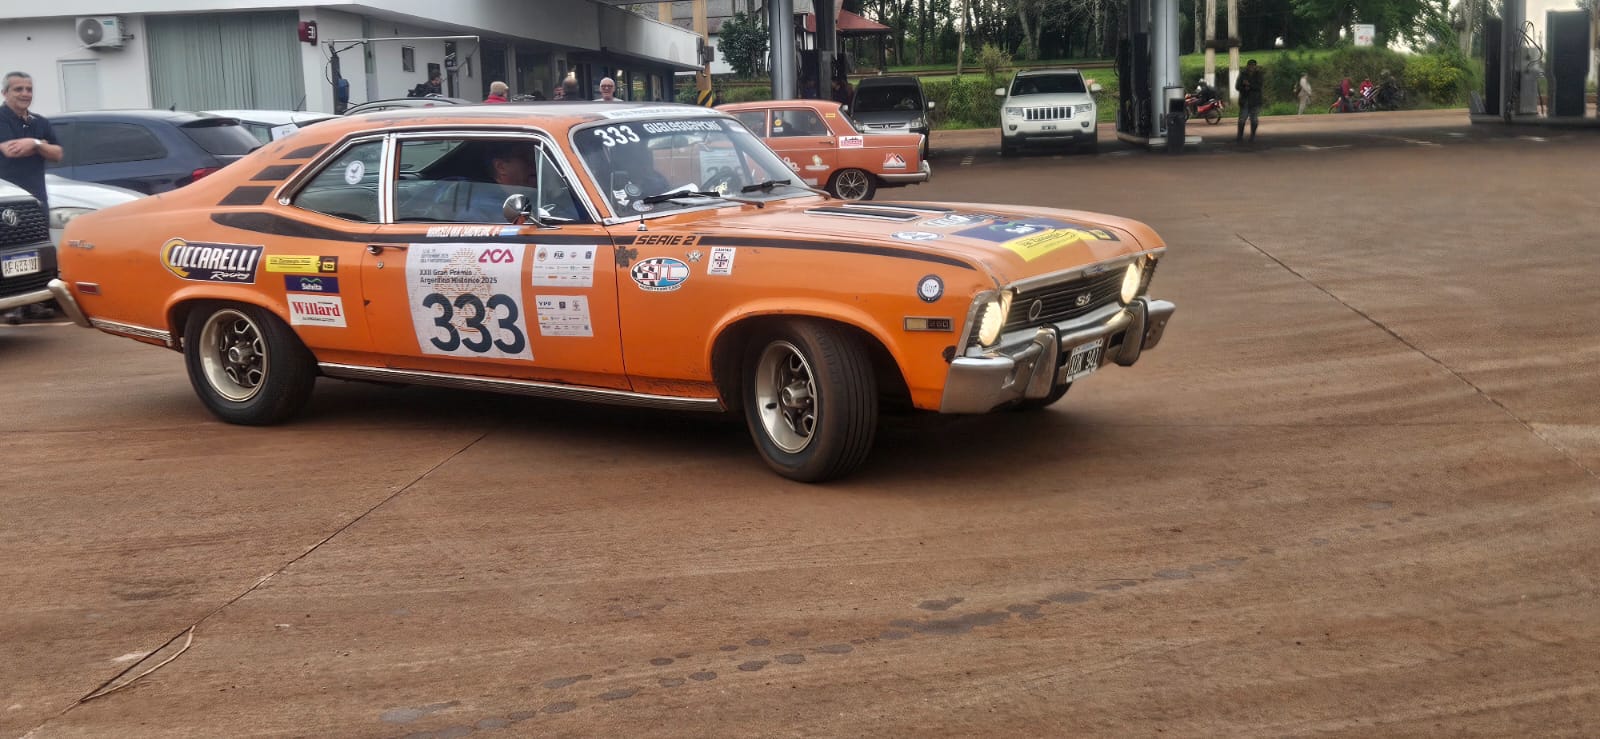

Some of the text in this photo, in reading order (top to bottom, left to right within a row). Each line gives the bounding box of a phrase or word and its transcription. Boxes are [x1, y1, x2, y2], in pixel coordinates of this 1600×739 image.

[594, 125, 640, 147] 333
[636, 235, 697, 246] SERIE 2
[170, 245, 258, 272] CICCARELLI
[478, 248, 514, 263] ACA
[210, 270, 250, 281] Racing
[420, 277, 450, 285] Argentino
[481, 276, 498, 284] 2025
[292, 301, 341, 317] Willard
[422, 293, 526, 355] 333
